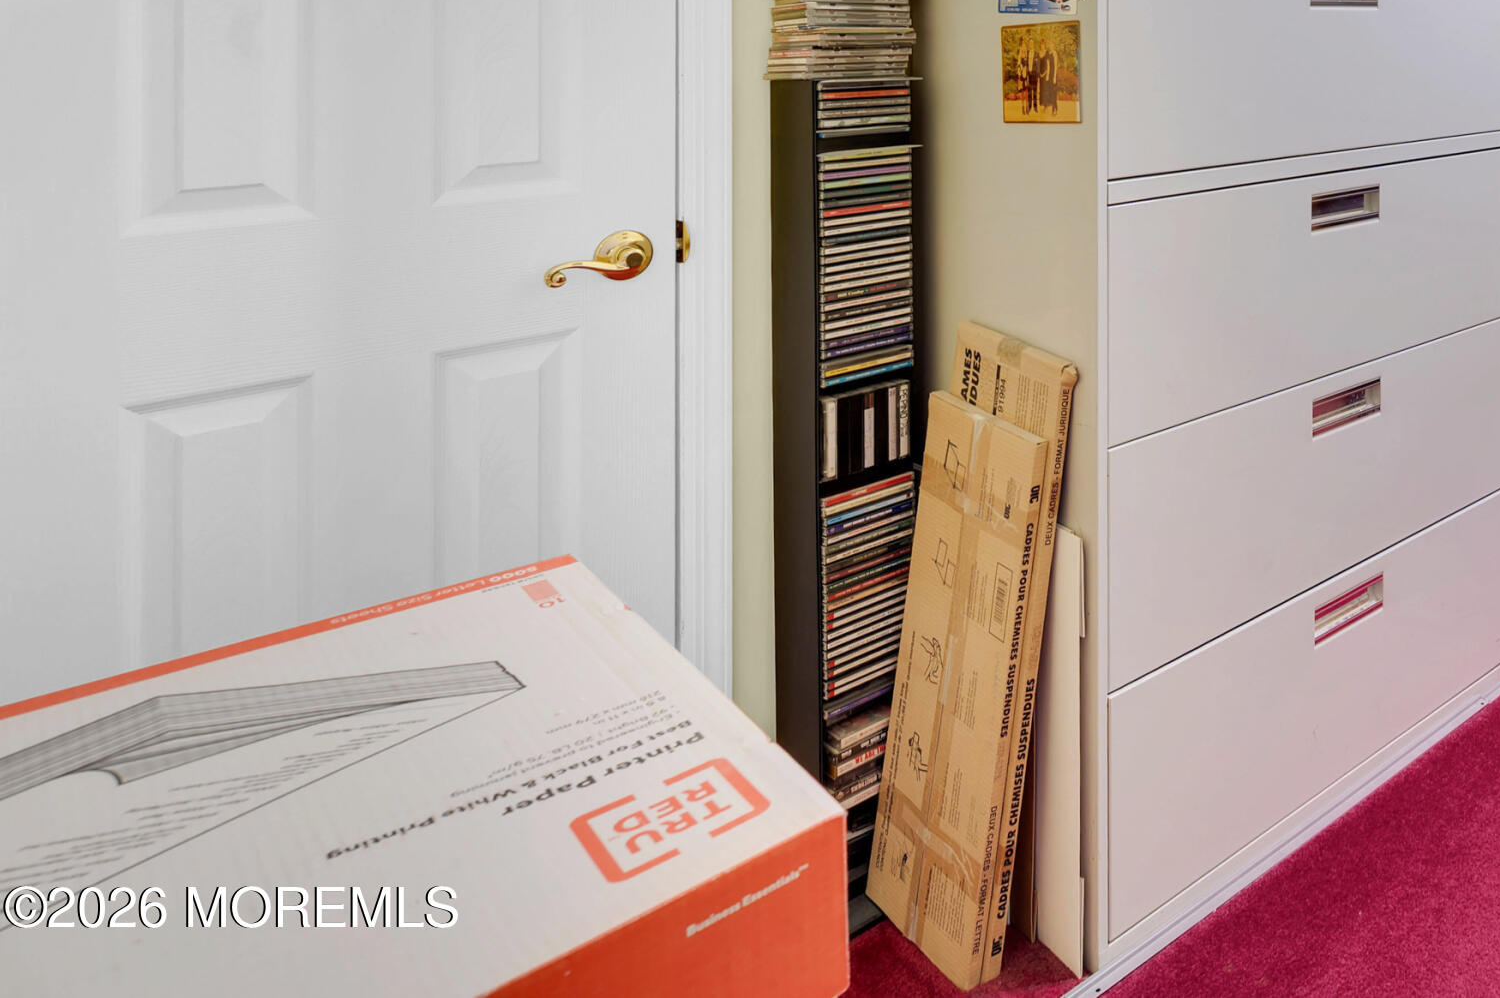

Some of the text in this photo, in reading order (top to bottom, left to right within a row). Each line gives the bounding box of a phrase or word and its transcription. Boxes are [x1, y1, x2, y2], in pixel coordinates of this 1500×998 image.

[960, 347, 972, 402] AMES
[1058, 388, 1070, 437] JURIDIQUE
[1053, 439, 1065, 475] FORMAT
[1048, 482, 1058, 519] CADRES
[1045, 521, 1053, 546] DEUX
[435, 578, 486, 597] Letter
[488, 565, 538, 583] 5000
[330, 604, 394, 625] Sheets
[397, 592, 432, 608] Size
[1000, 523, 1034, 738] CADRES POUR CHEMISES SUSPENDUES
[326, 719, 692, 861] Best For Black & White Printing
[502, 731, 705, 816] Printer Paper
[613, 795, 698, 834] RED
[625, 780, 732, 854] TRU
[987, 805, 998, 831] DEUX
[997, 678, 1035, 920] CADRES POUR CHEMISES SUSPENDUES
[983, 833, 994, 872] CADRES
[977, 878, 989, 917] FORMAT
[685, 901, 741, 938] Business
[972, 919, 983, 956] LETTRE
